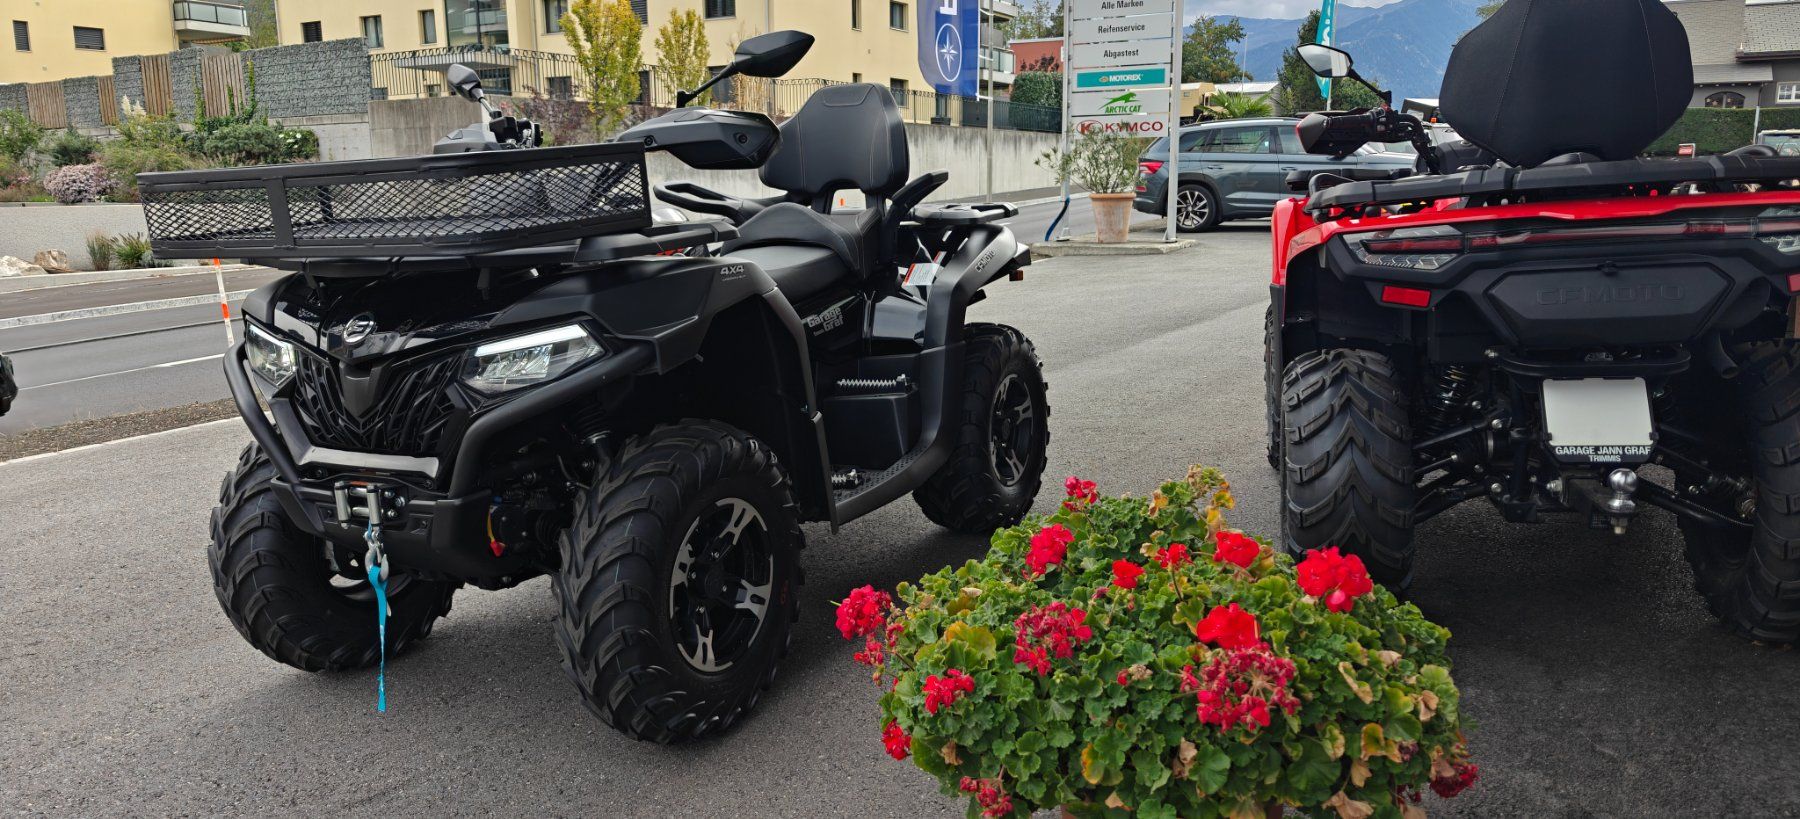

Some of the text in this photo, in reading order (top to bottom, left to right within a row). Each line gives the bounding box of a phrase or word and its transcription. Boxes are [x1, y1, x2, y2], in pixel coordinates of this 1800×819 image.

[1101, 0, 1144, 10] Alle Marken
[1098, 23, 1146, 34] Reifenservice
[1103, 49, 1139, 59] Abgastest
[1109, 74, 1142, 82] MOTOREX
[1105, 105, 1142, 114] ARCTIC CAT
[1105, 121, 1164, 133] KYMCO
[1536, 281, 1687, 305] CFMOTO
[1556, 446, 1651, 455] GARAGE JANN GRAF
